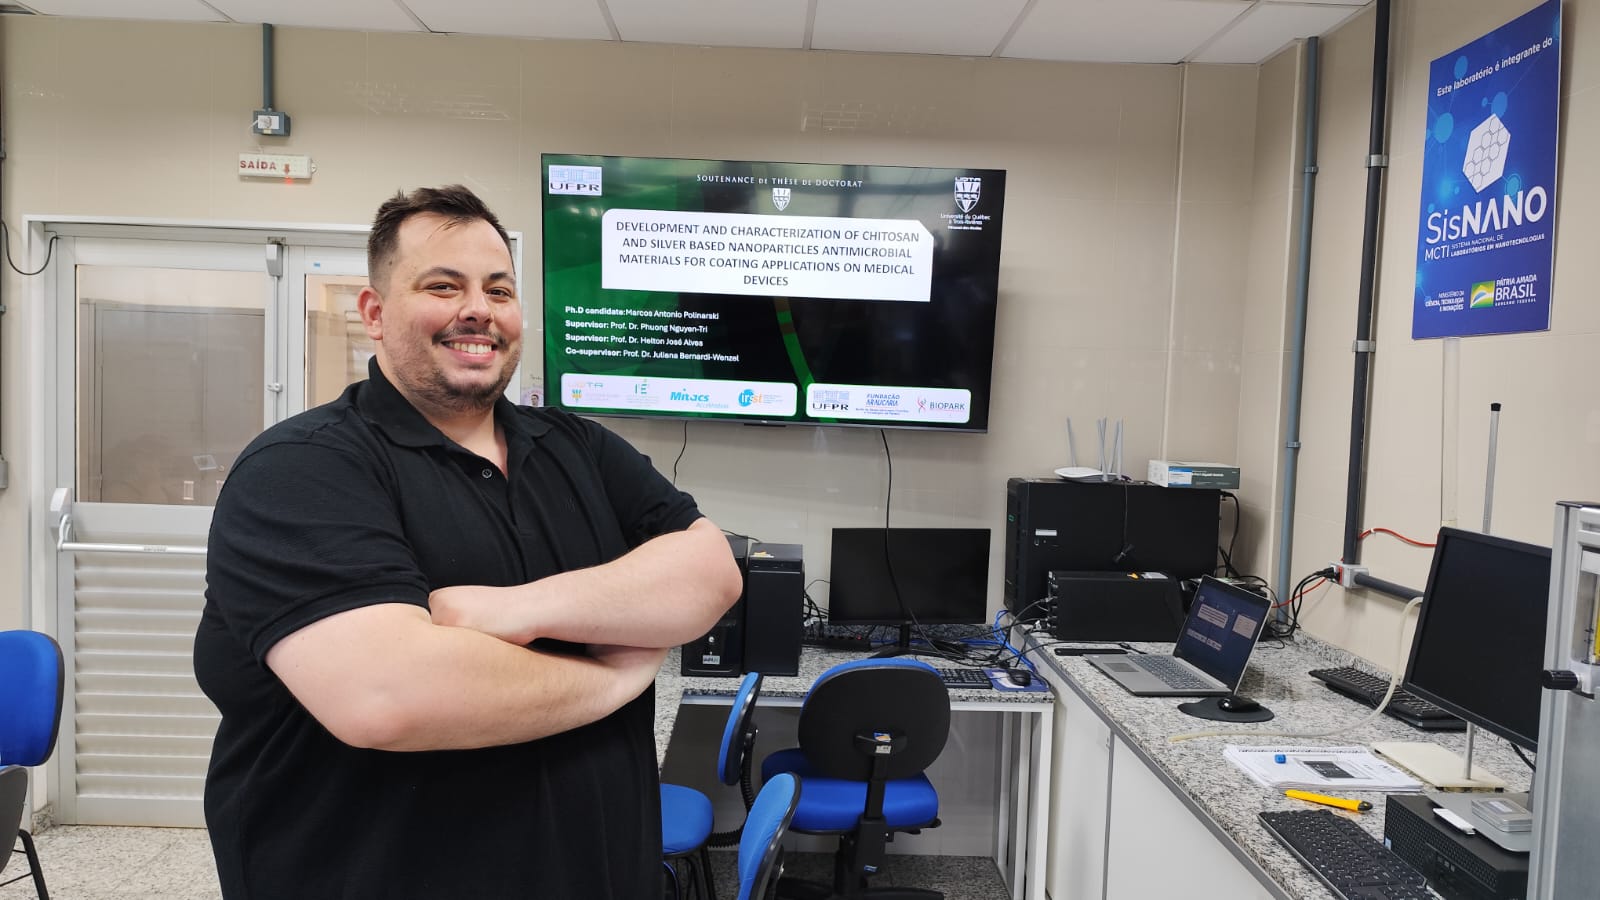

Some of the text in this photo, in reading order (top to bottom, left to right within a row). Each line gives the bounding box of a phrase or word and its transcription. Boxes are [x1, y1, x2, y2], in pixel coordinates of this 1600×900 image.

[1436, 36, 1552, 97] Este laboratório é integrante do
[240, 158, 276, 170] SAÍDA
[550, 182, 600, 192] UFPR
[816, 180, 862, 188] DOCTORAT
[1426, 186, 1548, 244] SisNANO
[616, 221, 920, 242] DEVELOPMENT AND CHARACTERIZATION OF CHITOSAN
[622, 238, 912, 258] AND SILVER BASED NANOPARTICLES ANTIMICROBIAL
[1472, 236, 1496, 246] NACIONAL
[1494, 233, 1545, 249] NANOTECNOLOGIAS
[619, 254, 914, 274] MATERIALS FOR COATING APPLICATIONS ON MEDICAL
[743, 275, 788, 286] DEVICES
[1516, 274, 1537, 284] AMADA
[1495, 283, 1537, 301] BRASIL
[564, 306, 584, 314] Ph.D
[654, 310, 682, 318] Antonio
[683, 311, 720, 320] Polinarski
[565, 320, 609, 329] Supervisor:
[610, 322, 627, 330] Prof.
[640, 324, 668, 333] Phuong
[670, 325, 708, 334] Nguyen-Tri
[565, 334, 609, 342] Supervisor:
[610, 336, 627, 344] Prof.
[640, 337, 664, 345] Helton
[666, 338, 682, 346] José
[684, 339, 704, 347] Alves
[565, 347, 622, 356] Co-supervisor:
[623, 350, 640, 358] Prof.
[652, 350, 678, 359] Juliana
[680, 352, 740, 362] Bernardi-Wenzel
[670, 388, 710, 402] Mitacs
[812, 402, 849, 411] UFPR
[929, 401, 965, 410] BIOPARK
